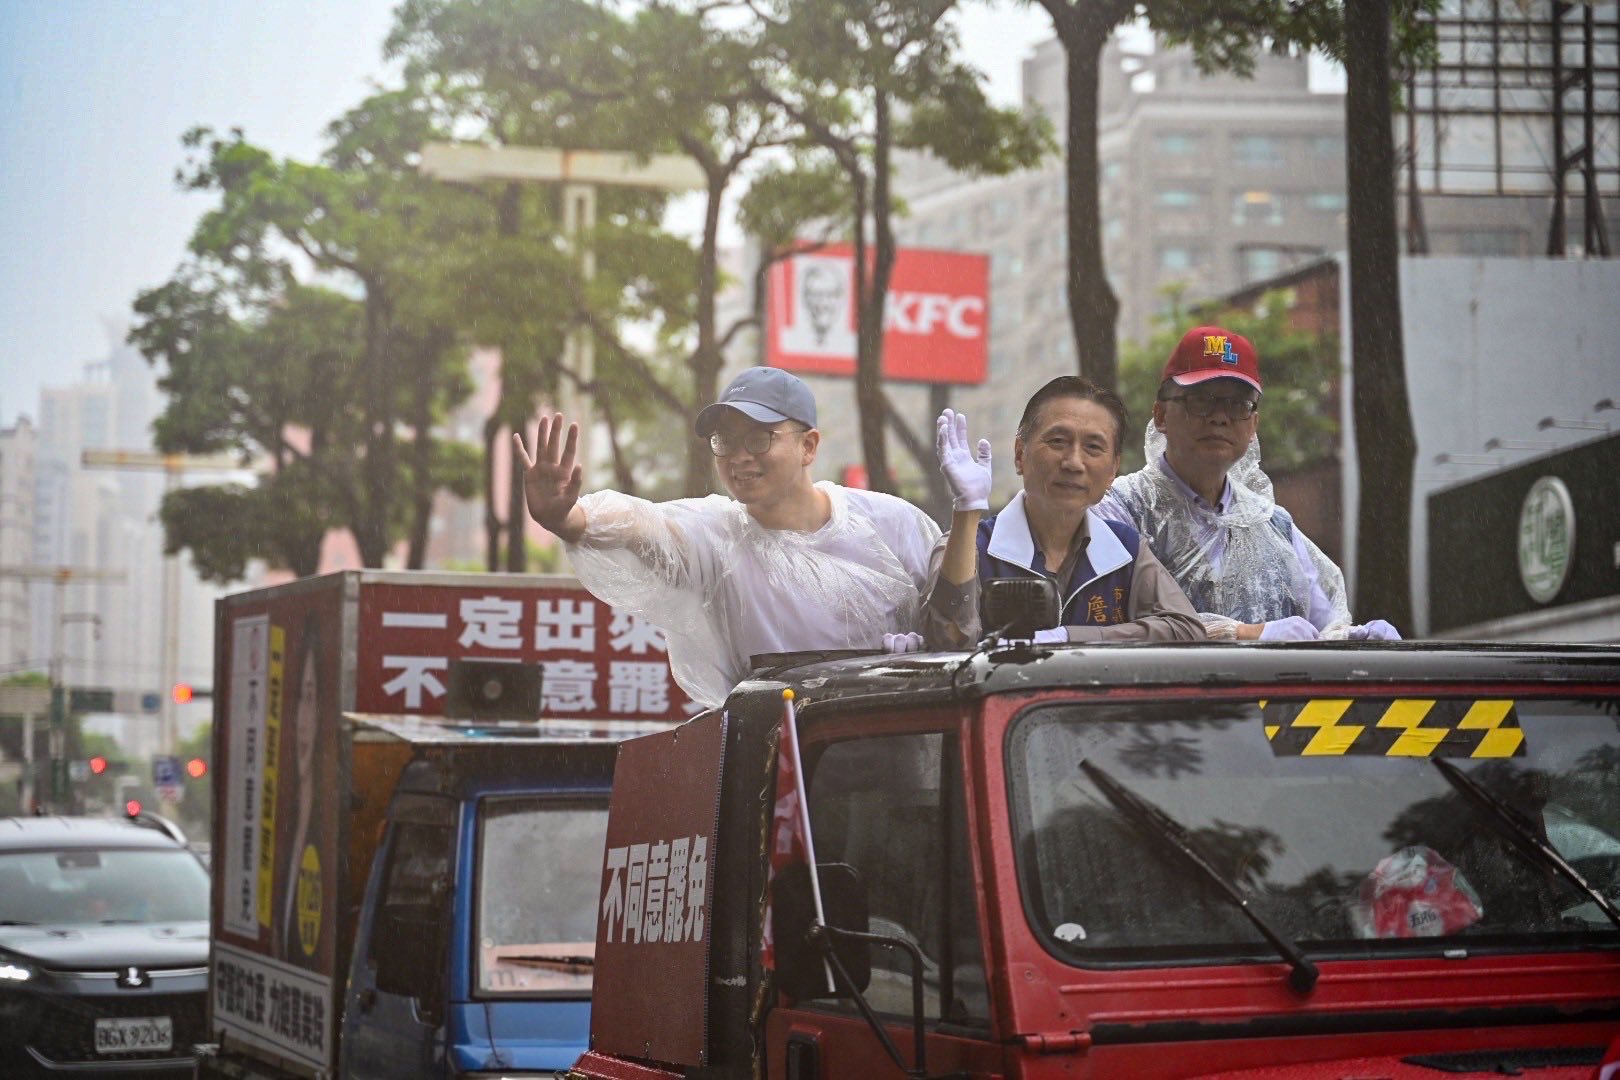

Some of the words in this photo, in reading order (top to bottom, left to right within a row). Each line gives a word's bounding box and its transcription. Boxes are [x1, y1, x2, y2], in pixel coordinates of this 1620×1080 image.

[882, 289, 984, 338] KFC
[1204, 336, 1237, 365] ML
[382, 596, 667, 654] 一定出來
[1086, 595, 1107, 623] 詹
[603, 834, 708, 944] 不同意罷免
